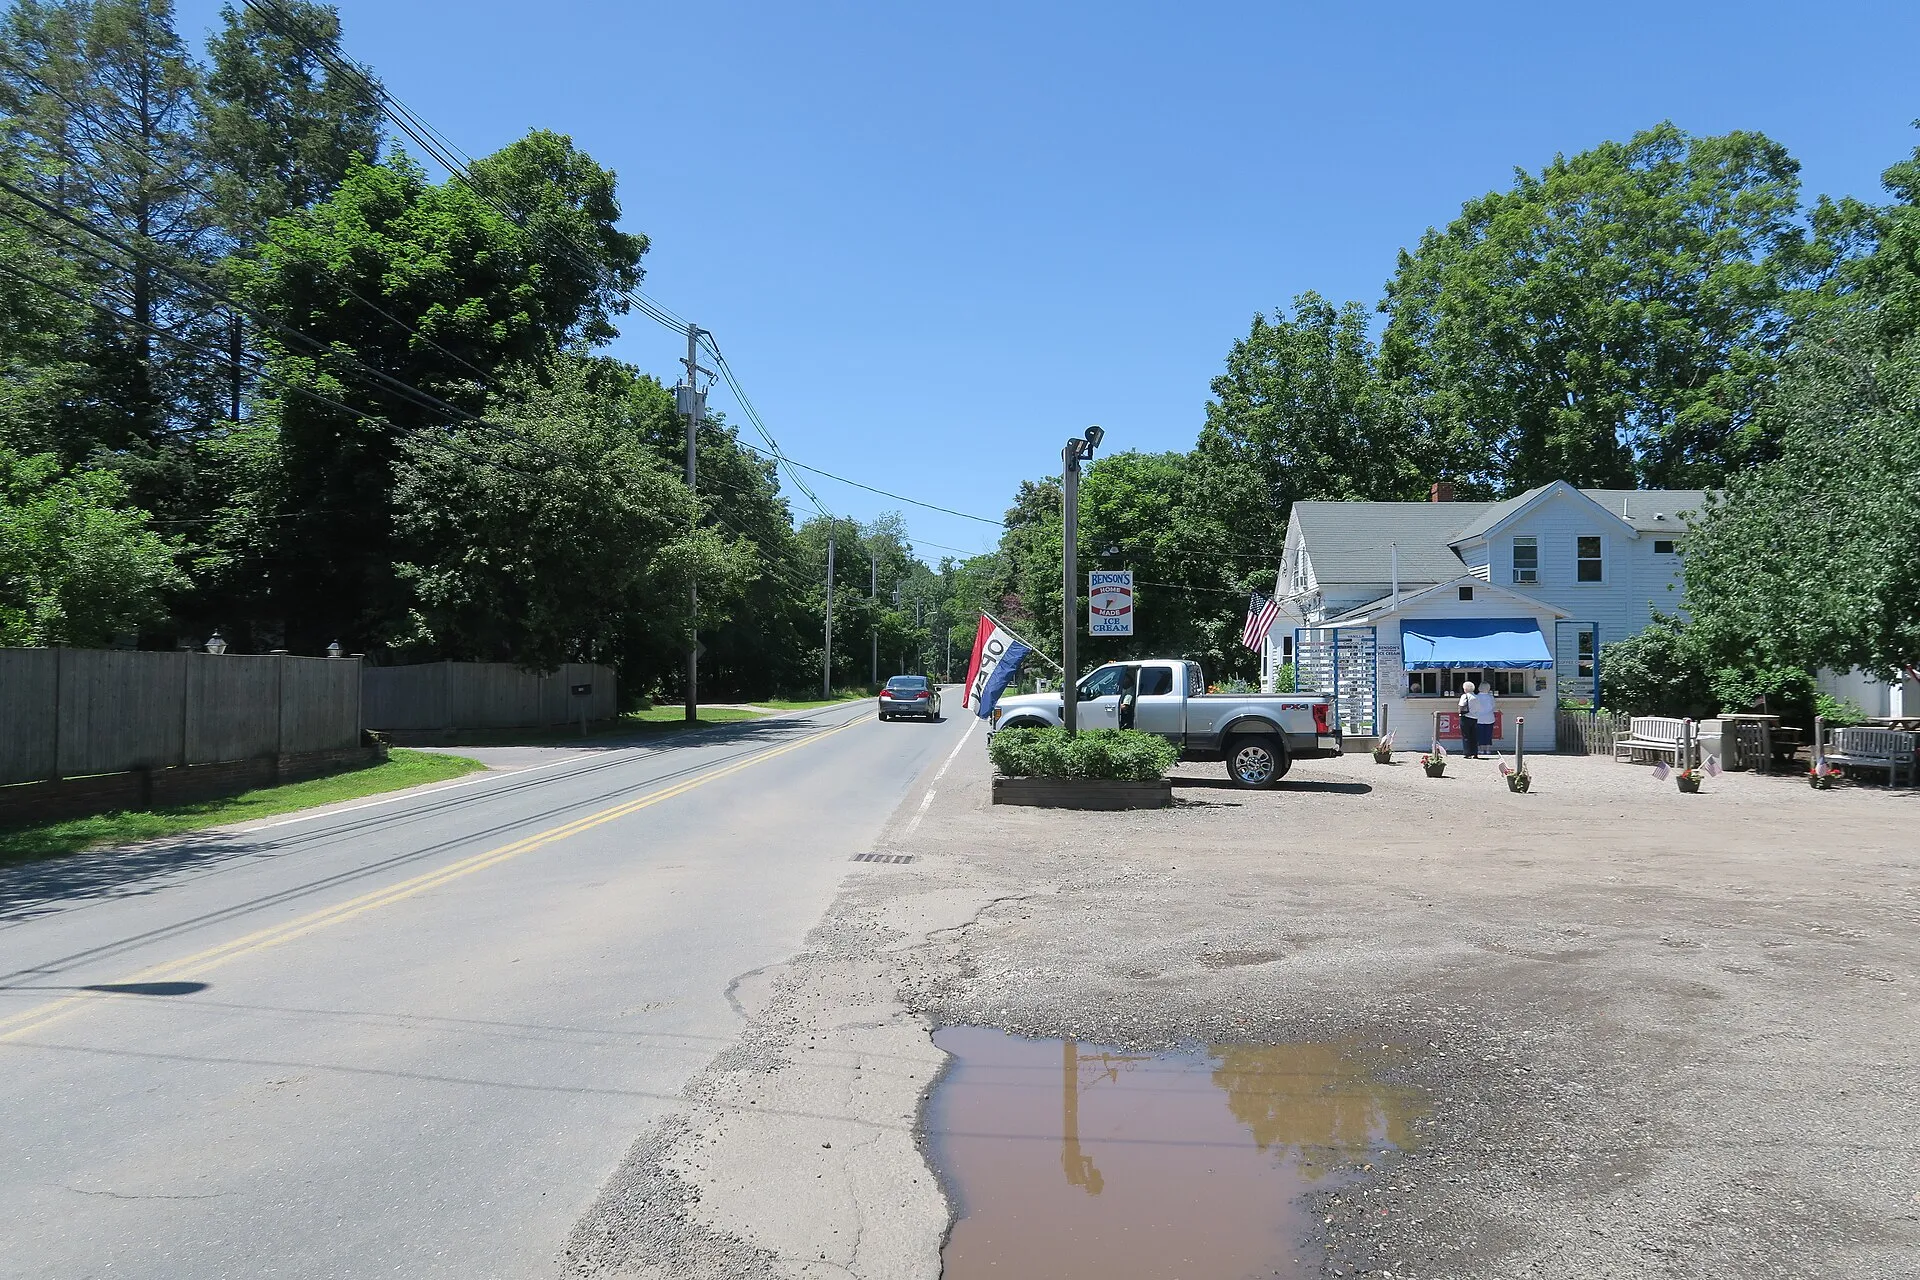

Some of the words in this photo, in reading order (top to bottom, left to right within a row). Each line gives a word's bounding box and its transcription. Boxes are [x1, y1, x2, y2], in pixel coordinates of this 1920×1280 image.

[1091, 573, 1131, 586] BENSON'S
[1103, 617, 1121, 625] ICE
[1092, 624, 1129, 632] CREAM
[1281, 703, 1309, 711] FX4
